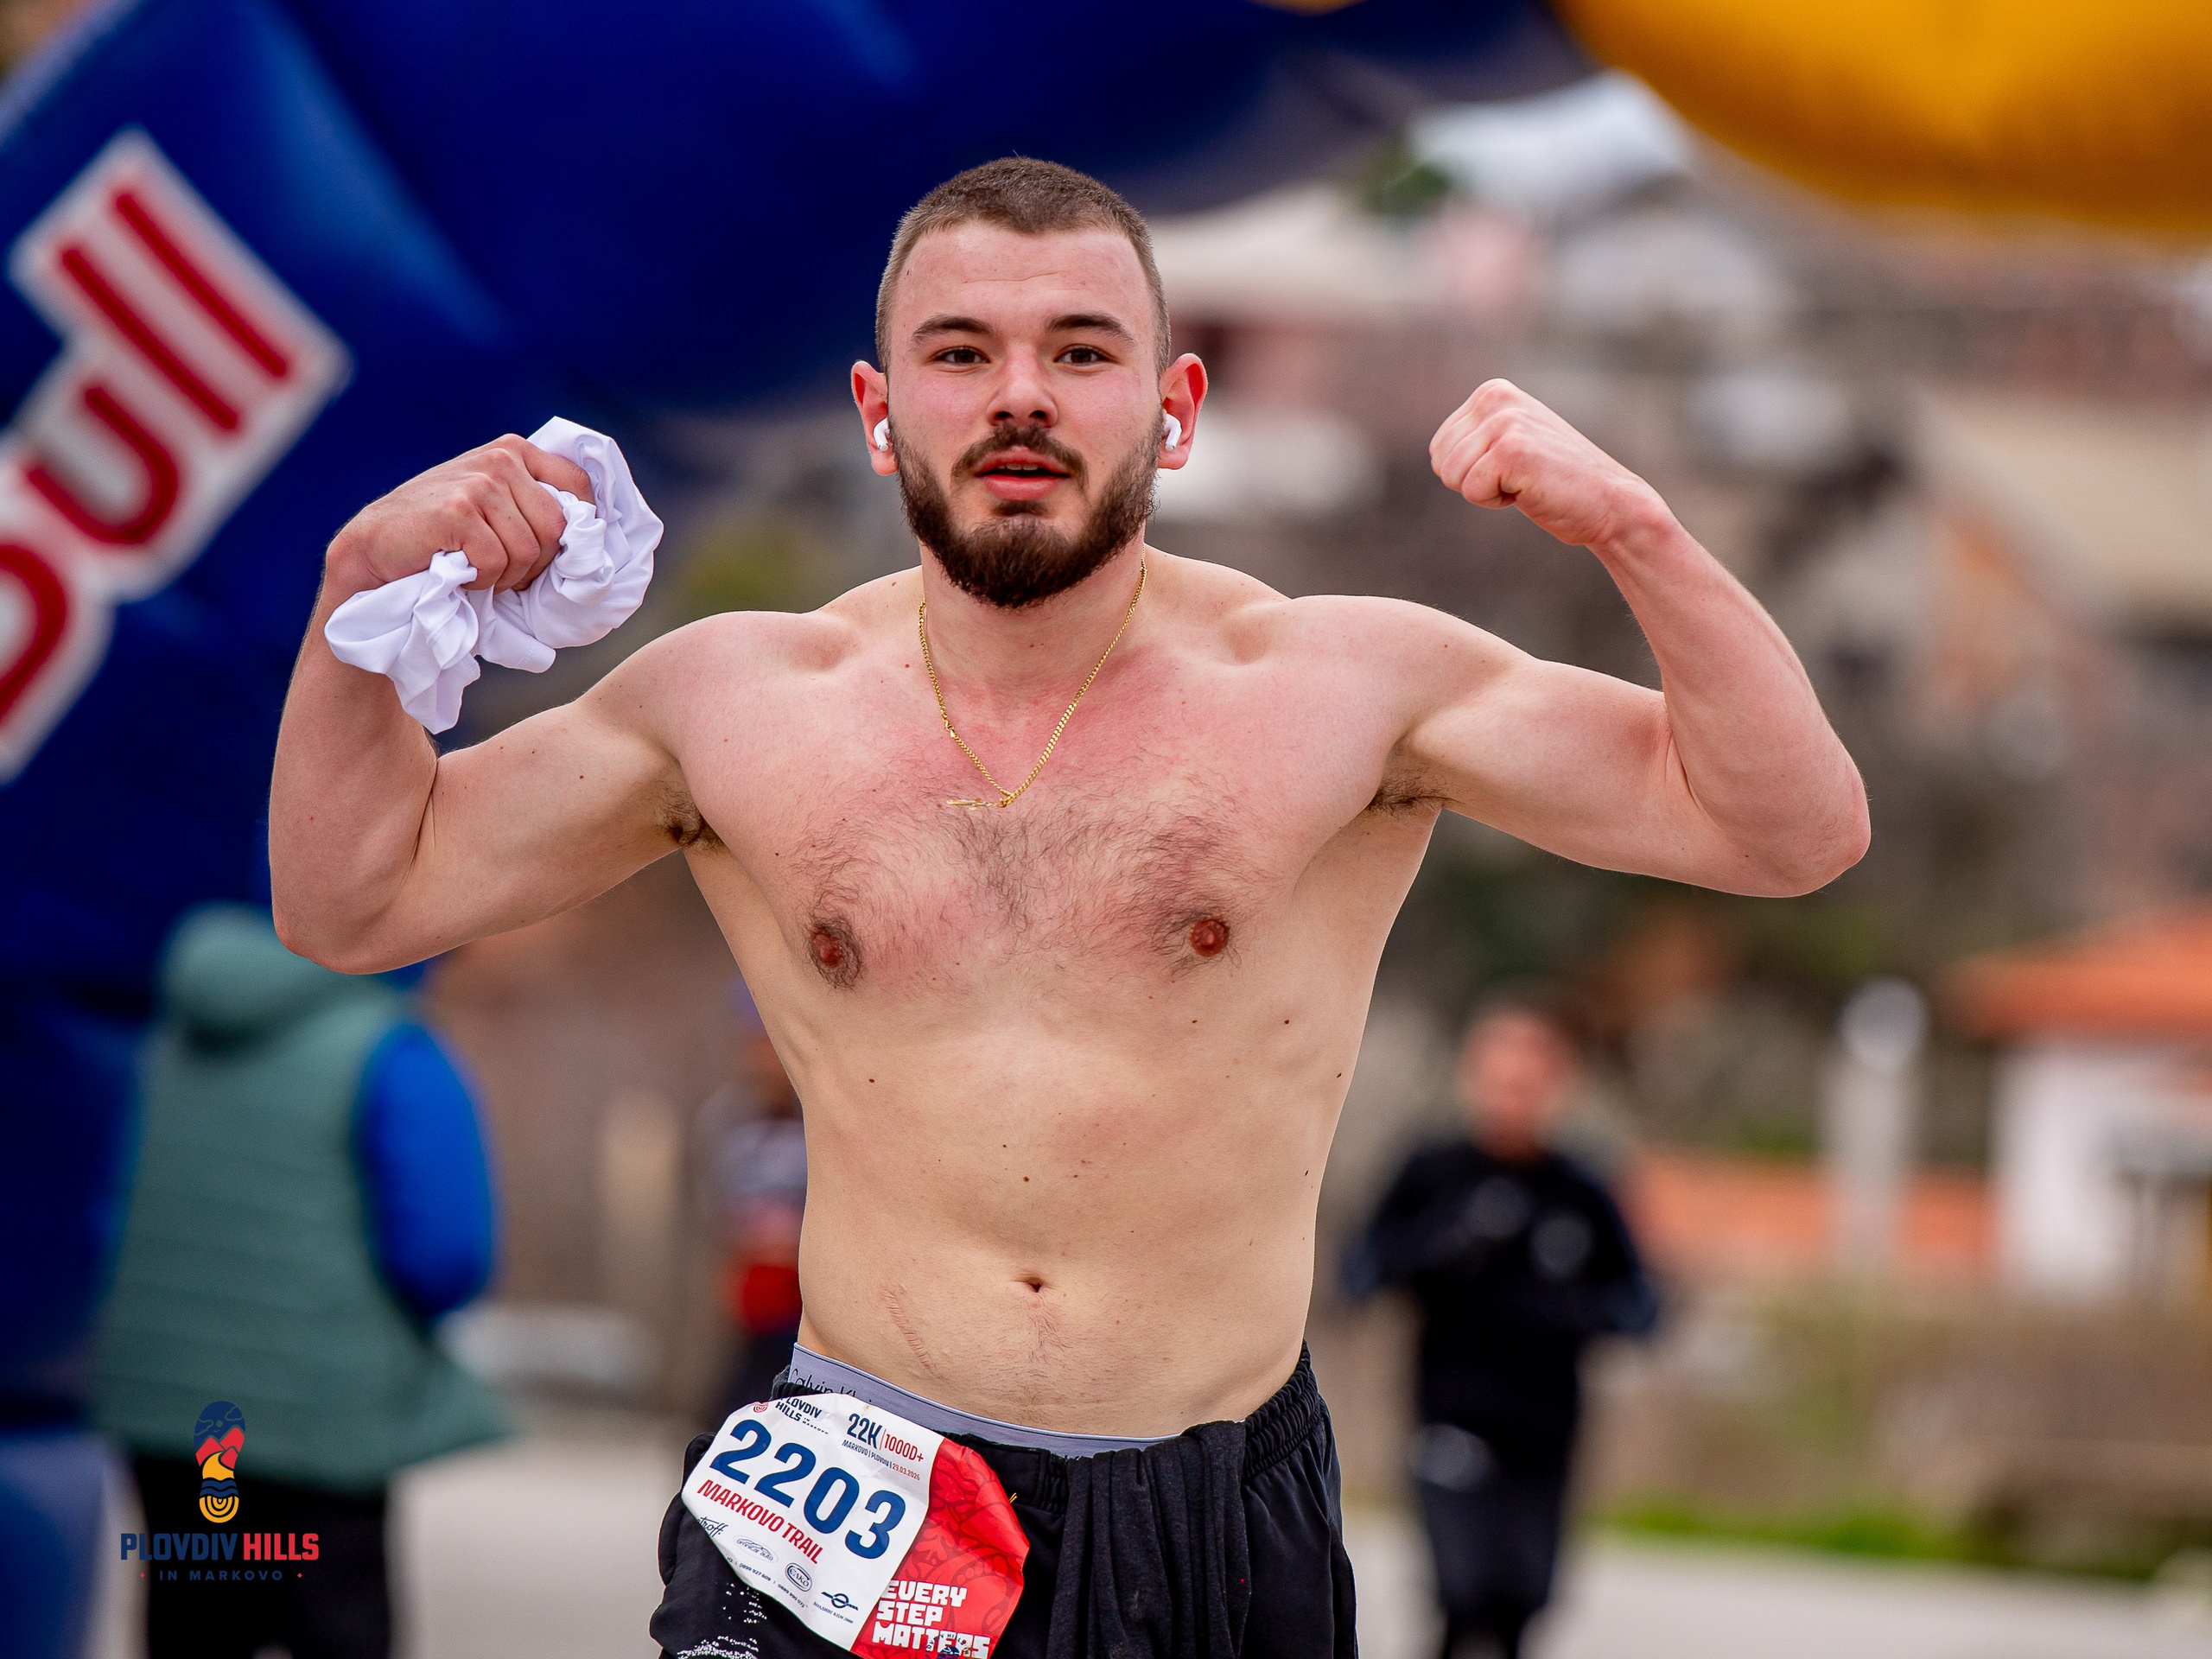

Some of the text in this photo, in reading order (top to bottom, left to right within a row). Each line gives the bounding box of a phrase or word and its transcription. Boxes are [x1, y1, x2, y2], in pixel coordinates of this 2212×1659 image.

[775, 1402, 802, 1421] HILLS
[847, 1413, 883, 1449] 22K
[842, 1439, 920, 1481] MARKOVO PLOVDIV 29.03.2026
[709, 1419, 906, 1559] 2203
[696, 1478, 823, 1565] MARKOVO TRAIL
[880, 1580, 968, 1607] EVERY
[876, 1599, 944, 1626] STEP
[872, 1621, 991, 1659] MATTERS
